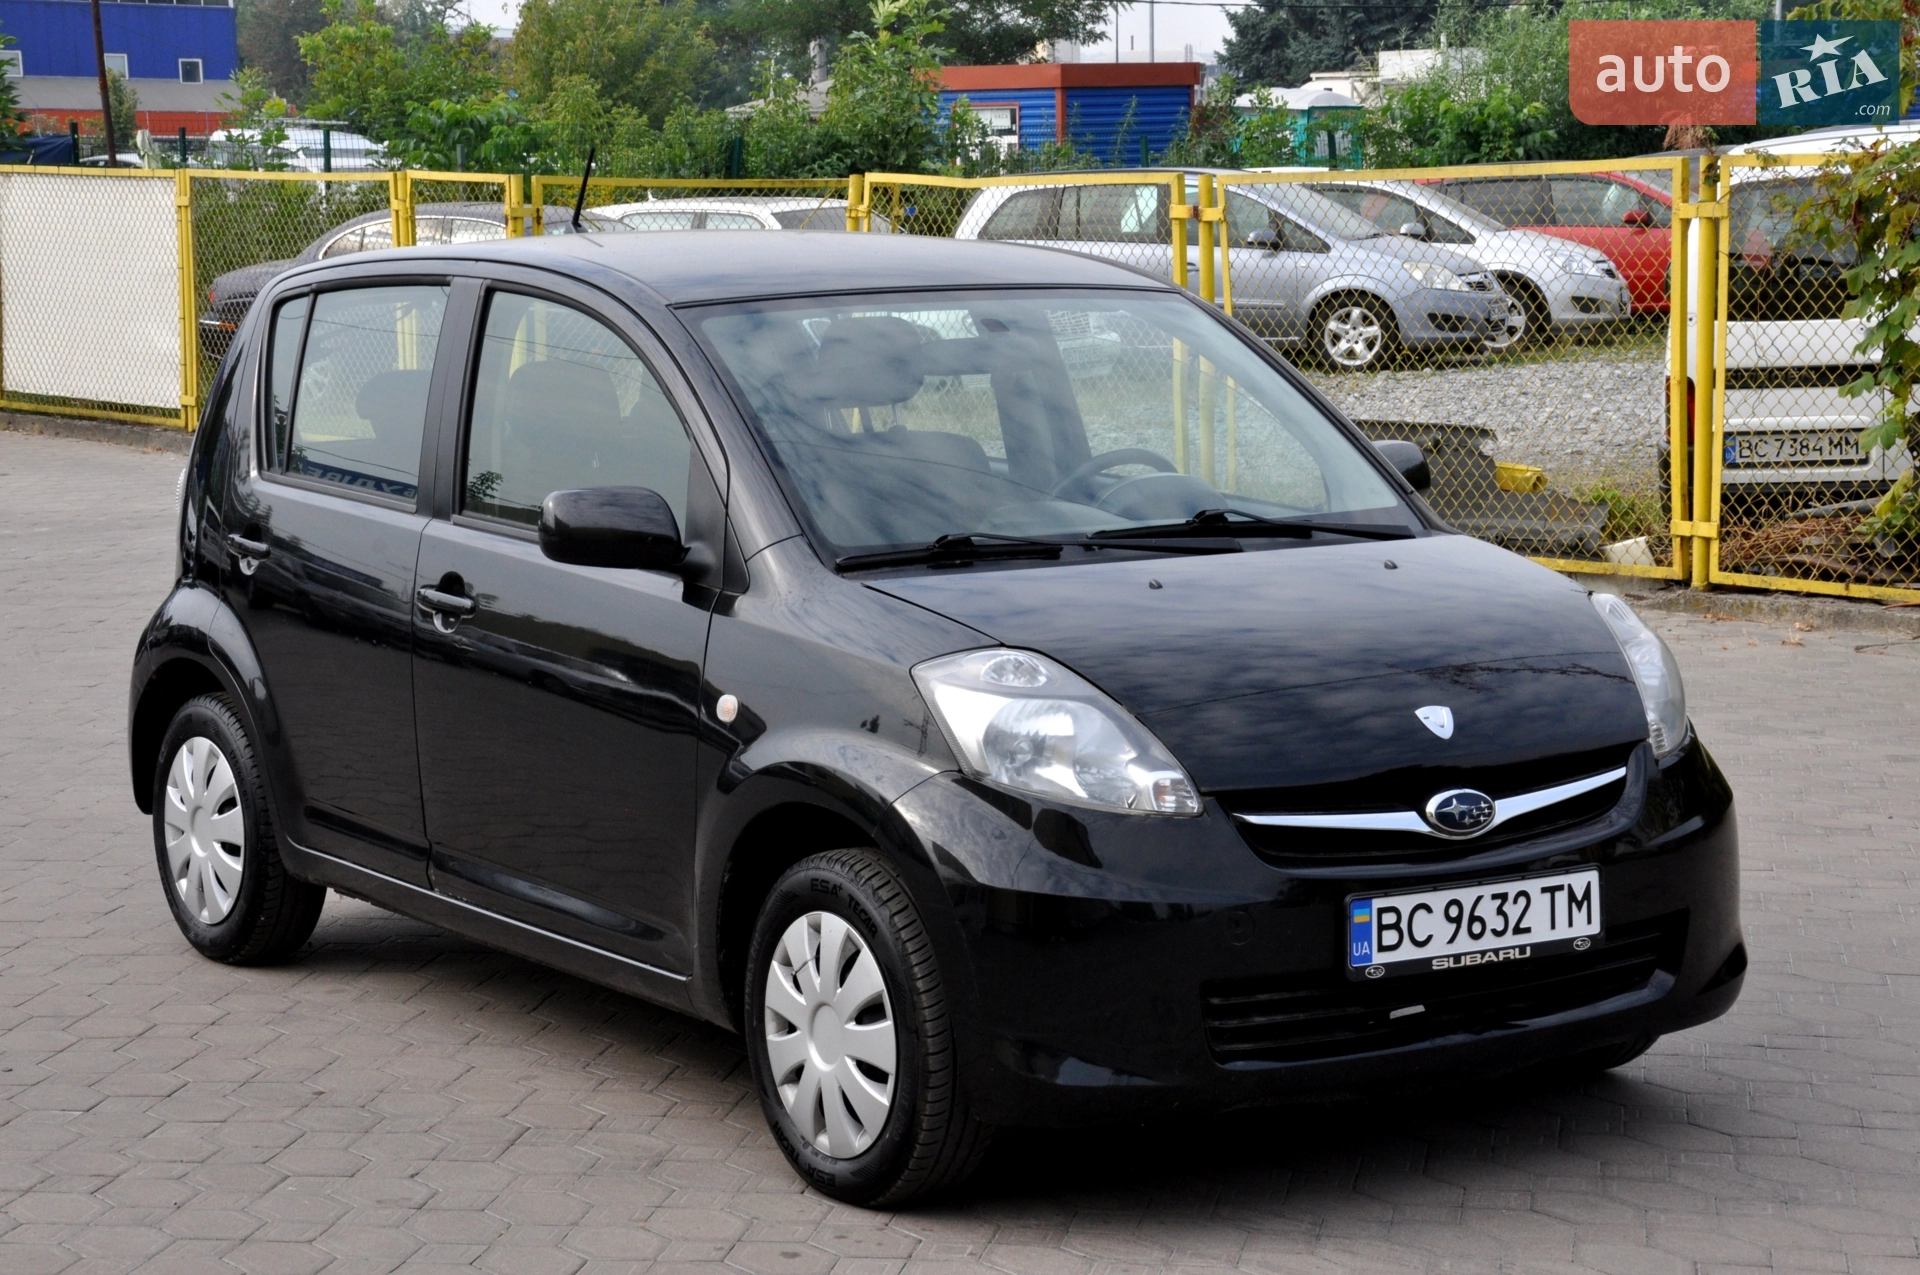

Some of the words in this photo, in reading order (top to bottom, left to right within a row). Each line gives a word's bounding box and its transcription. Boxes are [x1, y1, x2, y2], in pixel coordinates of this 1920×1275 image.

[1738, 439, 1768, 459] BC
[847, 893, 878, 939] TECAR
[1376, 902, 1434, 953] BC
[1443, 889, 1532, 945] 9632
[1540, 881, 1593, 930] TM
[1353, 942, 1371, 956] UA
[1432, 946, 1531, 970] SUBARU
